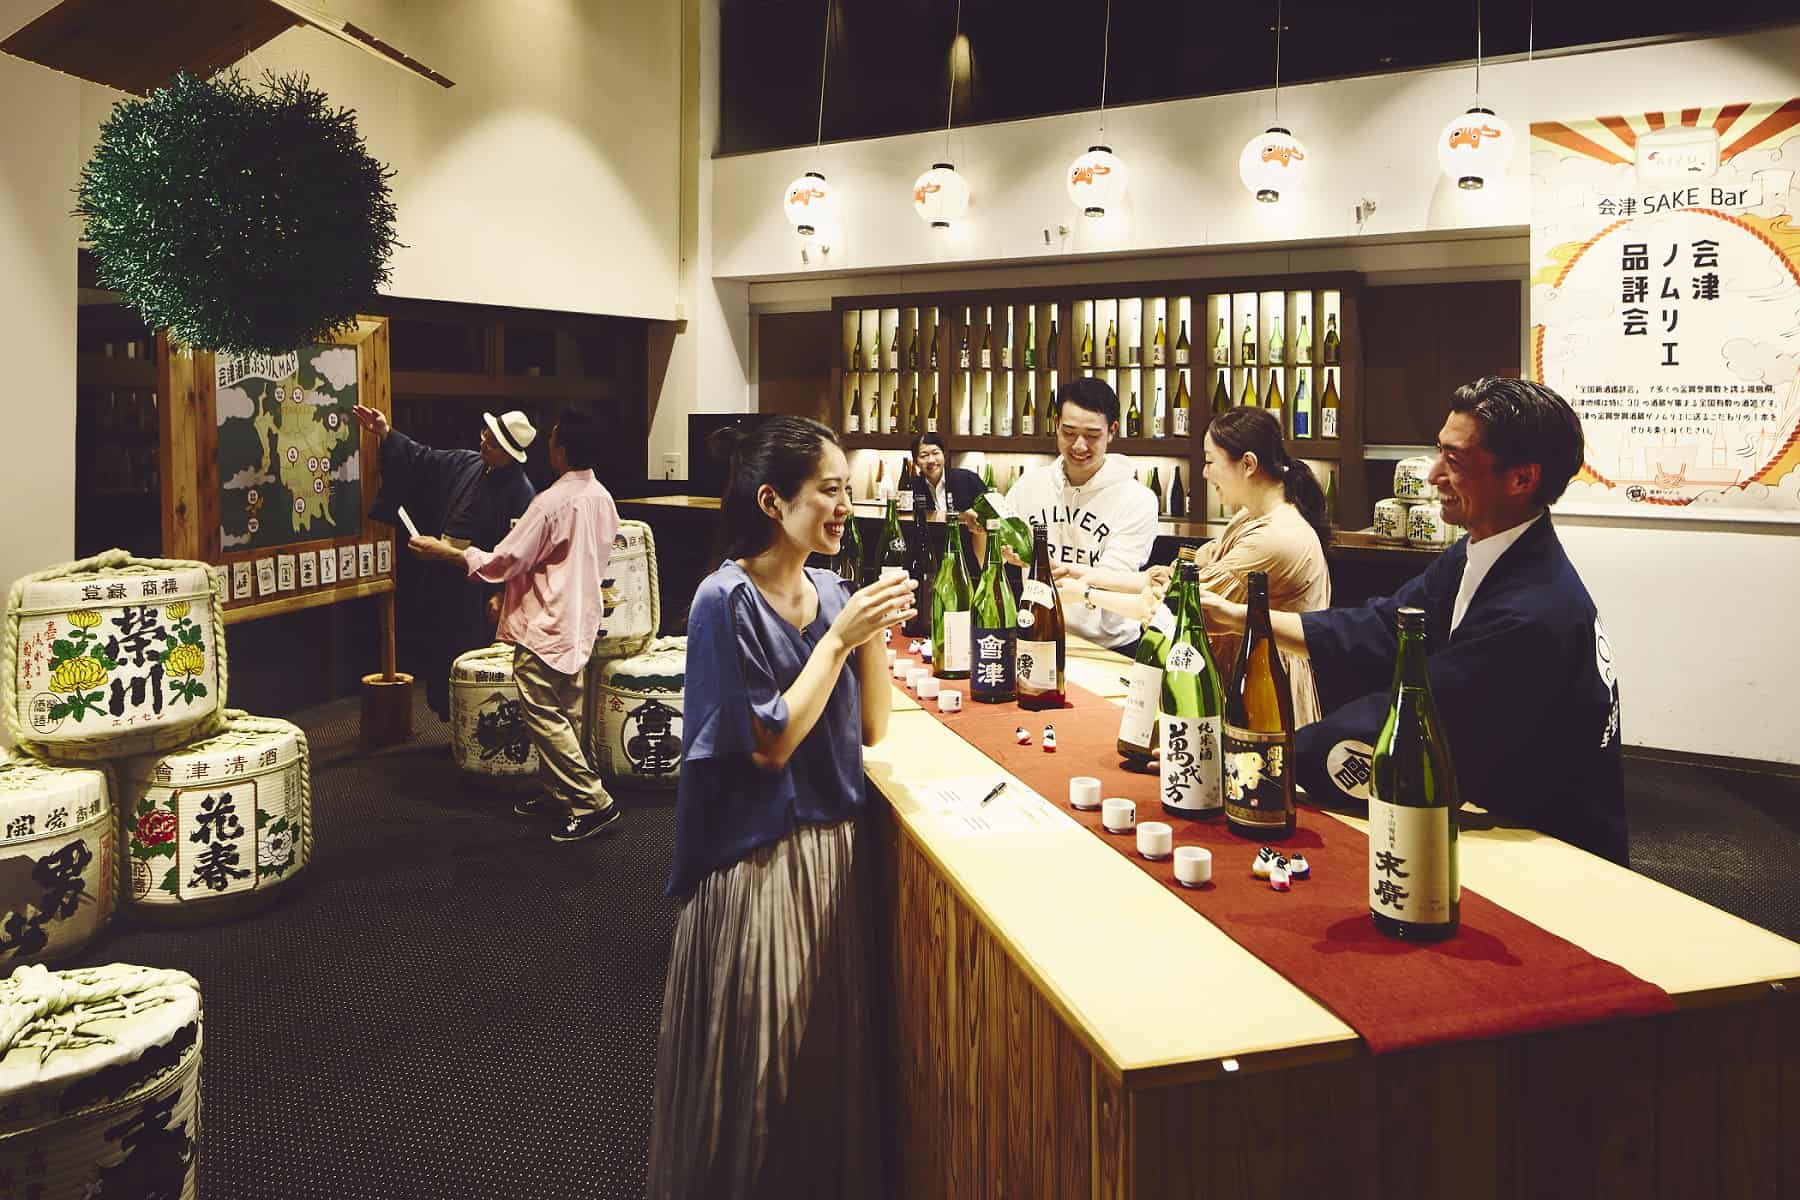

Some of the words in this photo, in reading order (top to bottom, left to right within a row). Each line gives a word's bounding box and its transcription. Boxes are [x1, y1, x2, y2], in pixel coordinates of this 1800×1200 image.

[1598, 197, 1637, 216] 会津
[1643, 187, 1700, 215] SAKE
[1710, 187, 1748, 206] Bar
[1622, 243, 1649, 336] 品評会
[1691, 239, 1719, 301] 会津
[1660, 243, 1680, 366] ノムリエ
[1047, 543, 1100, 568] REEK
[81, 584, 127, 601] 登録
[142, 577, 179, 596] 商標
[977, 634, 1007, 687] 會津
[1197, 721, 1214, 762] 純米酒
[188, 791, 251, 892] 花春
